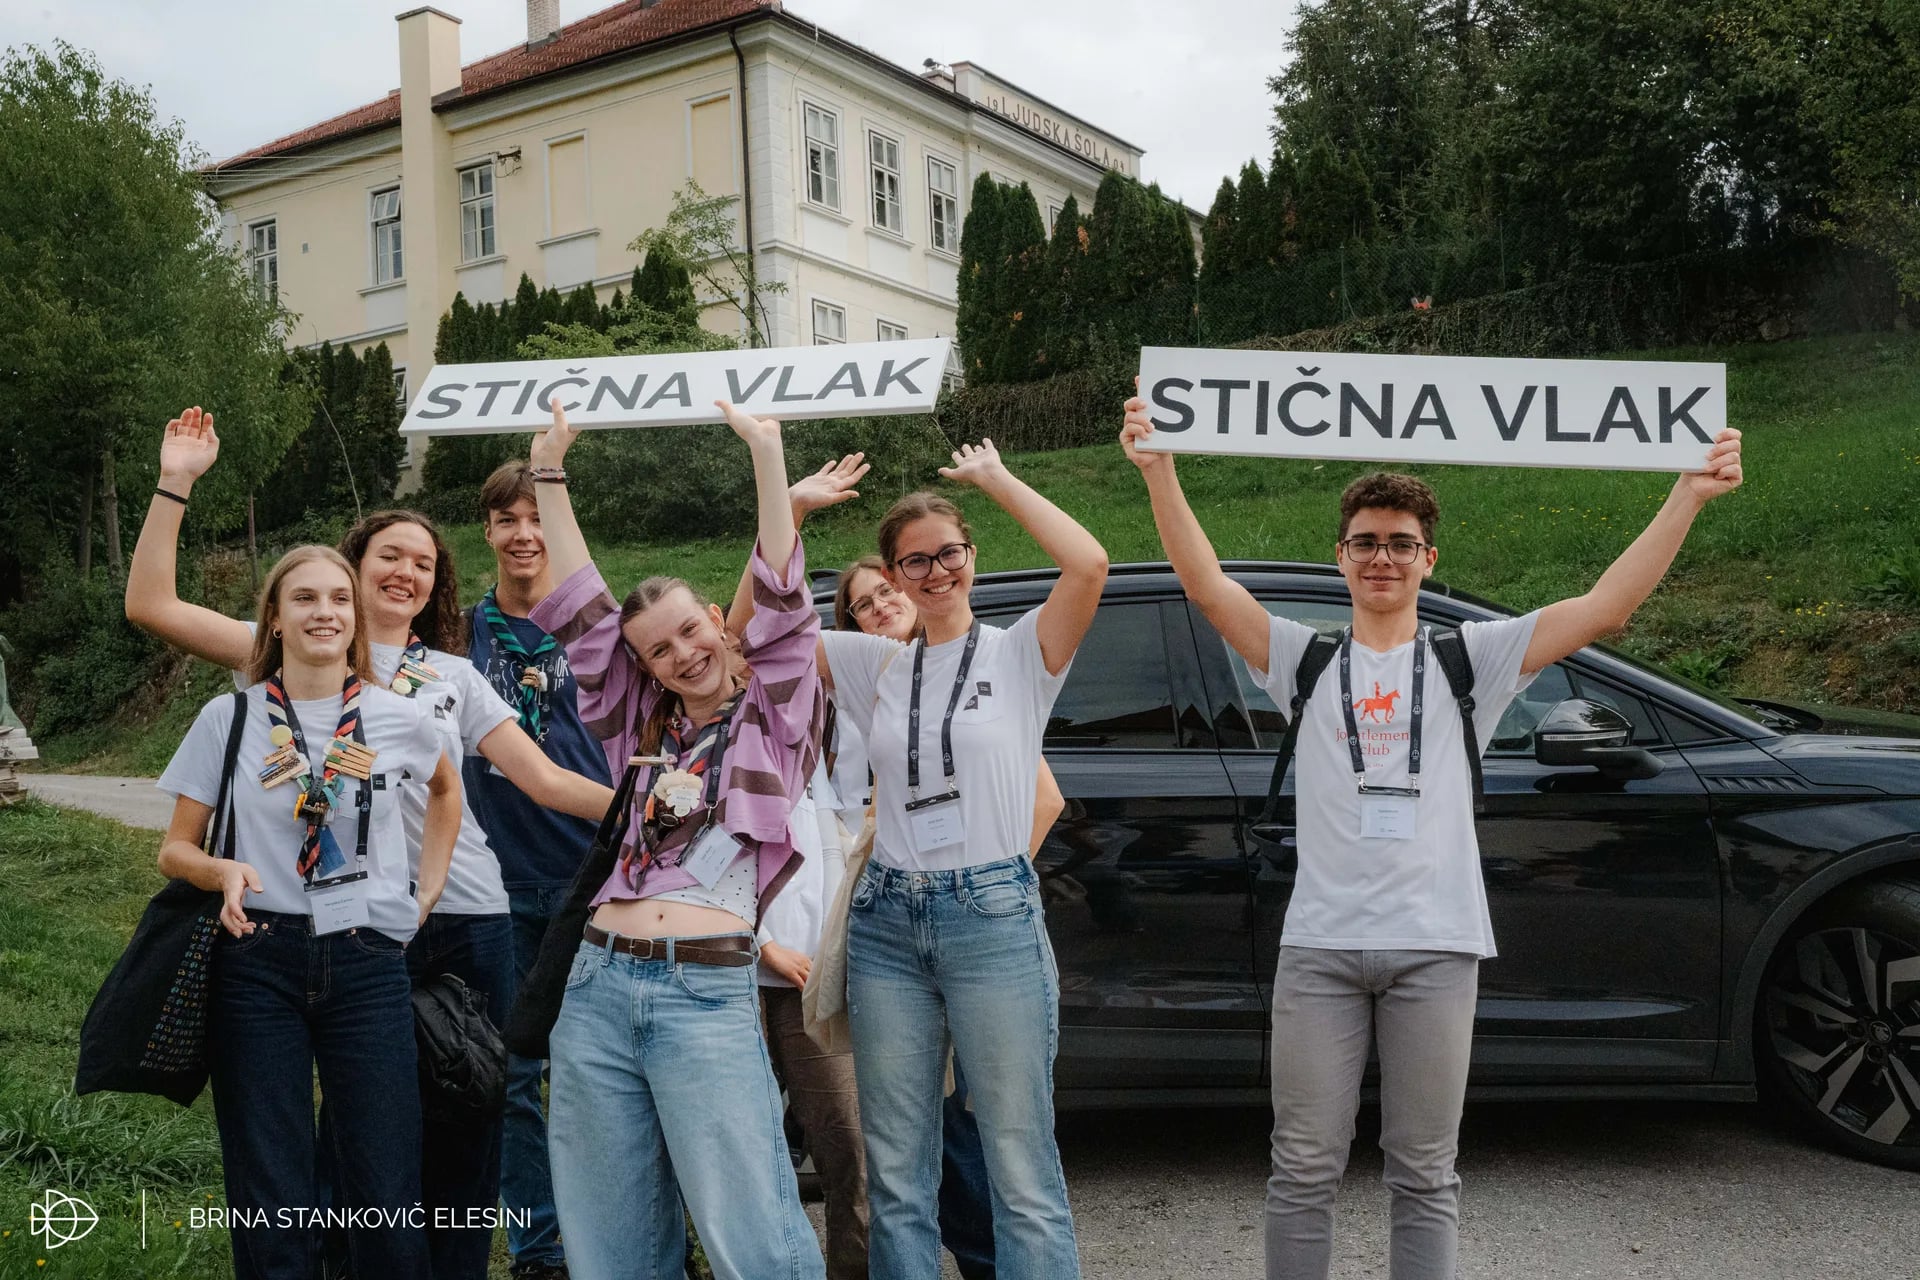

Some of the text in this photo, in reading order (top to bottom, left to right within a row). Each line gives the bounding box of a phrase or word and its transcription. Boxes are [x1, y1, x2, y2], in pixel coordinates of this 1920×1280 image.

[416, 357, 930, 419] STIČNA VLAK
[1150, 366, 1716, 444] STIČNA VLAK
